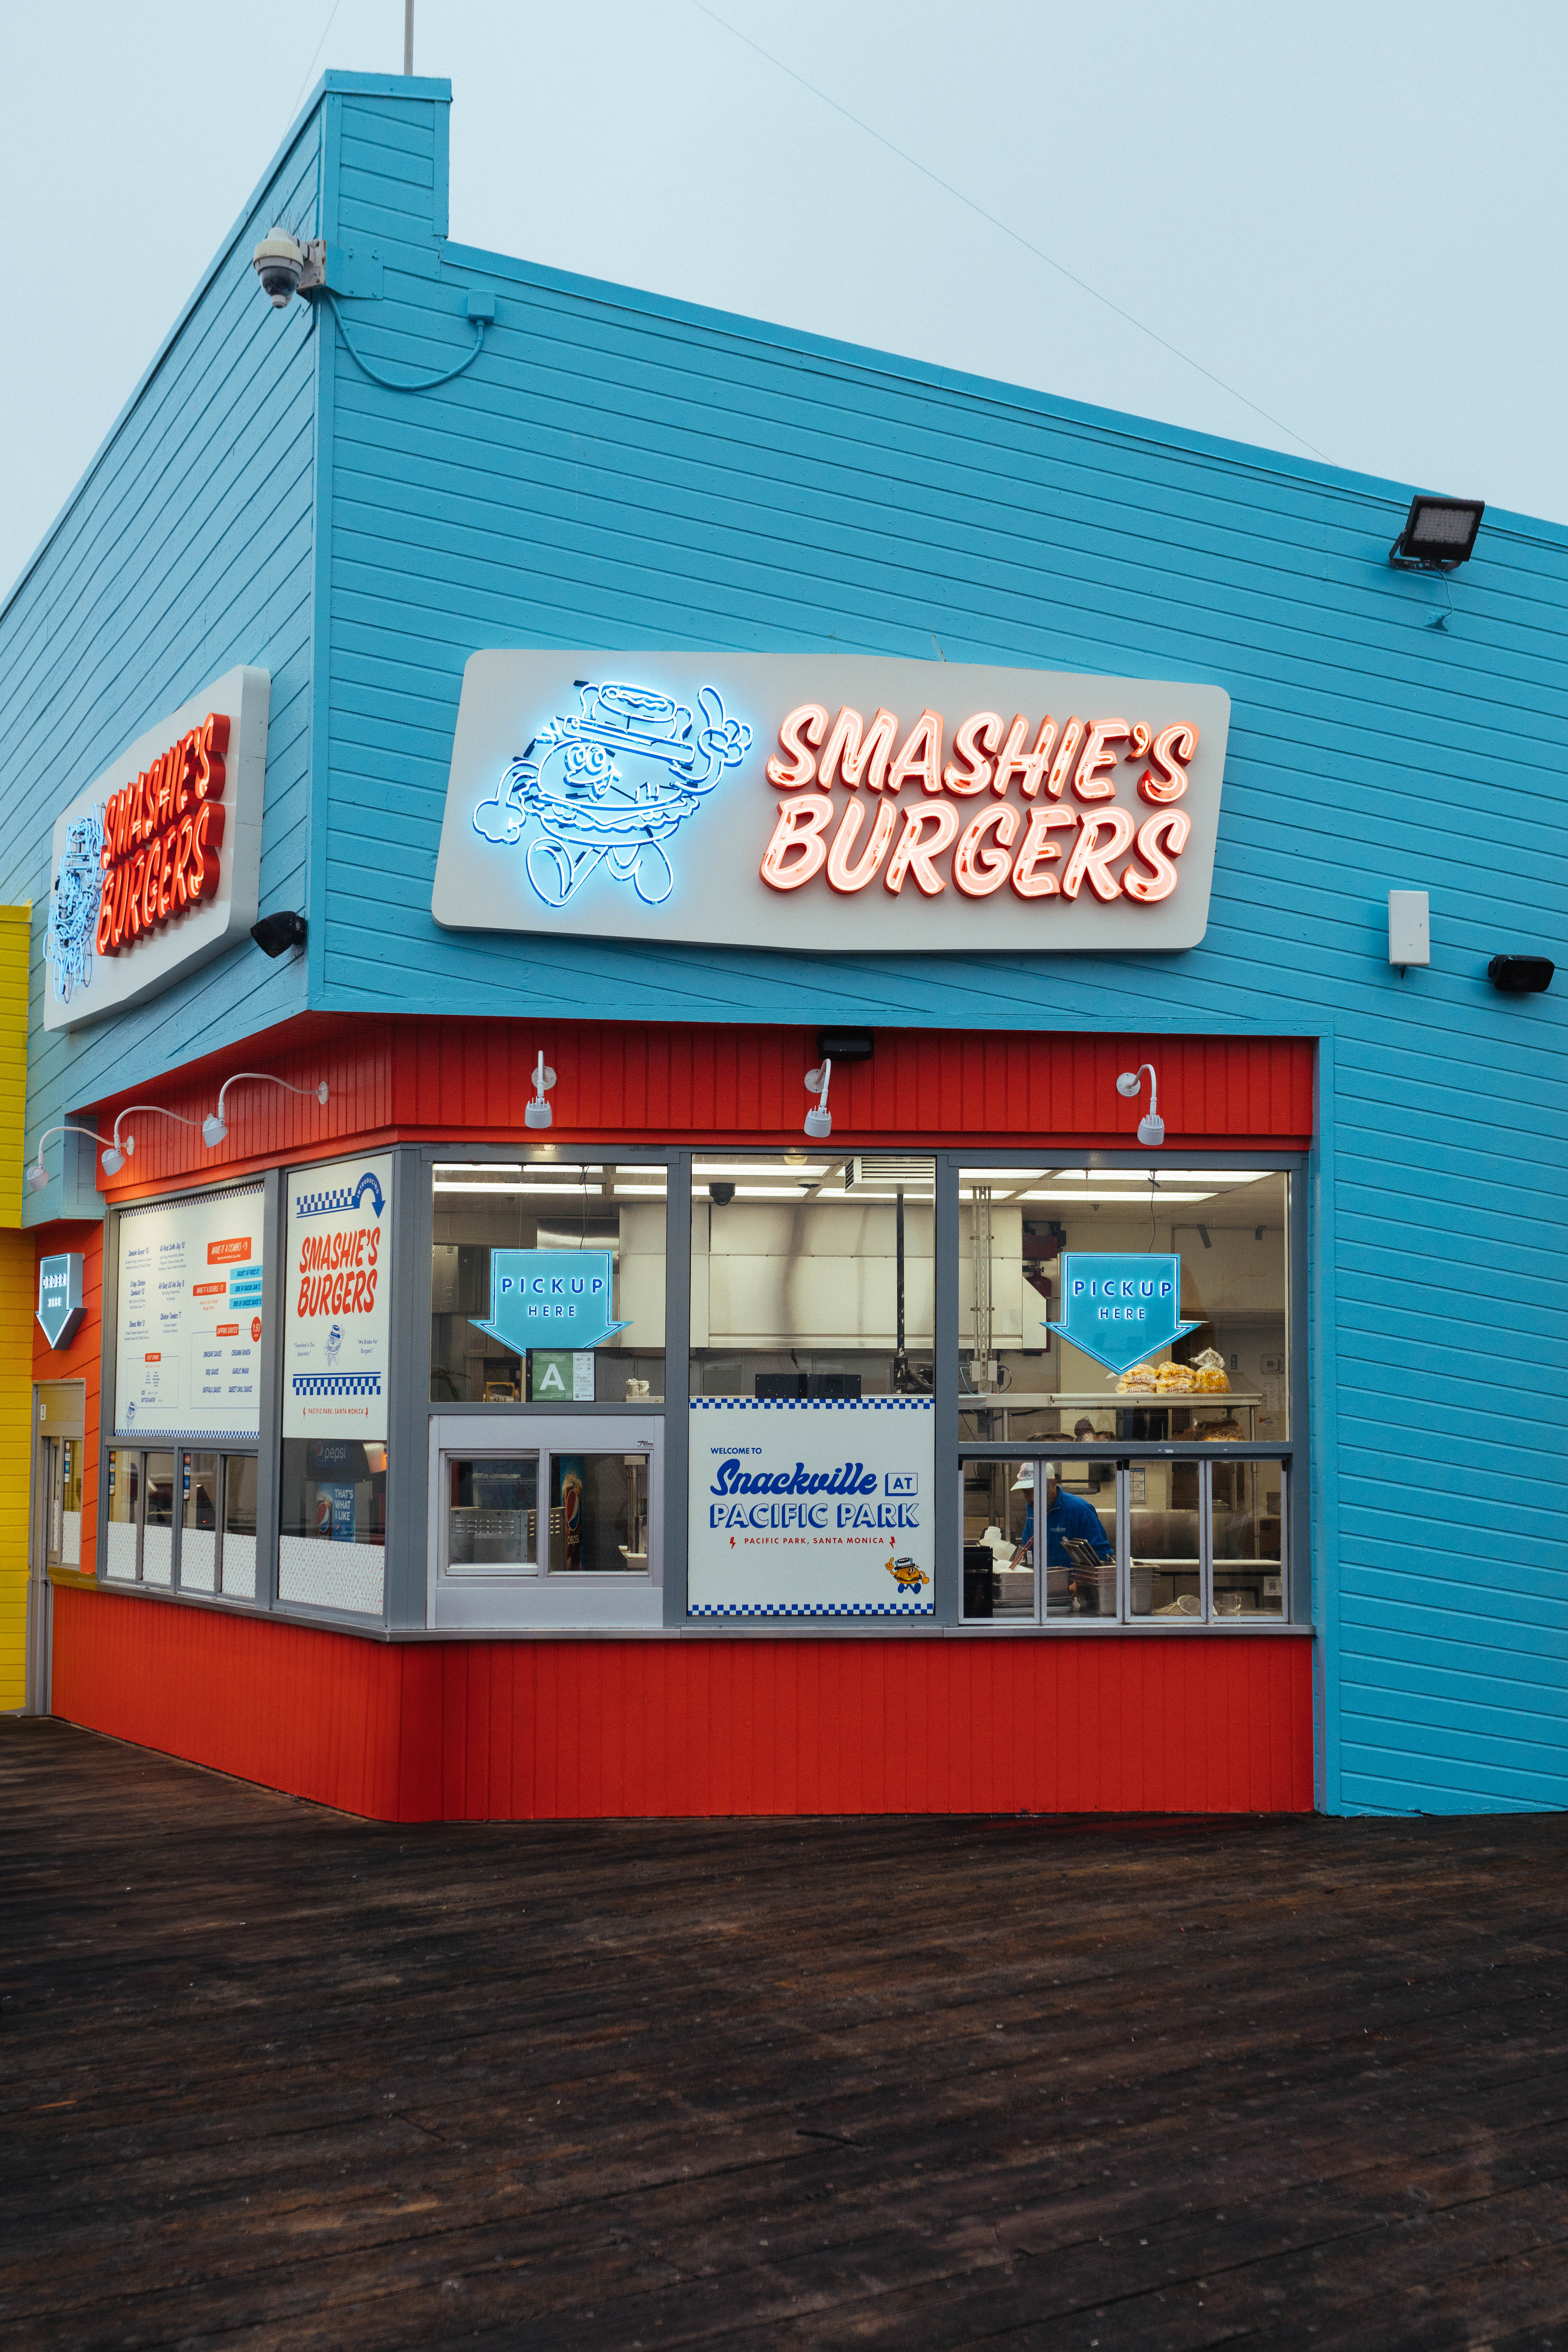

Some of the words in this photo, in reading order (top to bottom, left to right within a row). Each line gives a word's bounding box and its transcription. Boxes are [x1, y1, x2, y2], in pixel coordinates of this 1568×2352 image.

[766, 703, 1200, 805] SMASHIE'S
[101, 713, 230, 869] SMASHIE'S
[759, 793, 1192, 905] BURGERS
[97, 802, 225, 957] BURGERS
[357, 1177, 379, 1198] INTRODUCING
[211, 1245, 221, 1255] MAKE
[221, 1244, 225, 1253] IT
[225, 1244, 228, 1253] A
[228, 1242, 242, 1252] COMBO
[300, 1227, 380, 1273] SMASHIE'S
[43, 1274, 66, 1289] ORDER
[502, 1278, 603, 1294] PICKUP
[1073, 1281, 1172, 1297] PICKUP
[298, 1268, 377, 1318] BURGERS
[528, 1306, 576, 1317] HERE
[1099, 1308, 1145, 1319] HERE
[540, 1363, 565, 1390] A
[324, 1445, 346, 1462] pepsi
[710, 1458, 878, 1496] Snackville
[893, 1477, 913, 1489] AT
[335, 1489, 353, 1499] THAT'S
[335, 1500, 351, 1510] WHAT
[335, 1511, 337, 1520] I
[338, 1511, 350, 1521] LIKE
[710, 1503, 828, 1529] PACIFIC
[837, 1503, 920, 1528] PARK
[567, 1533, 579, 1547] pepsi
